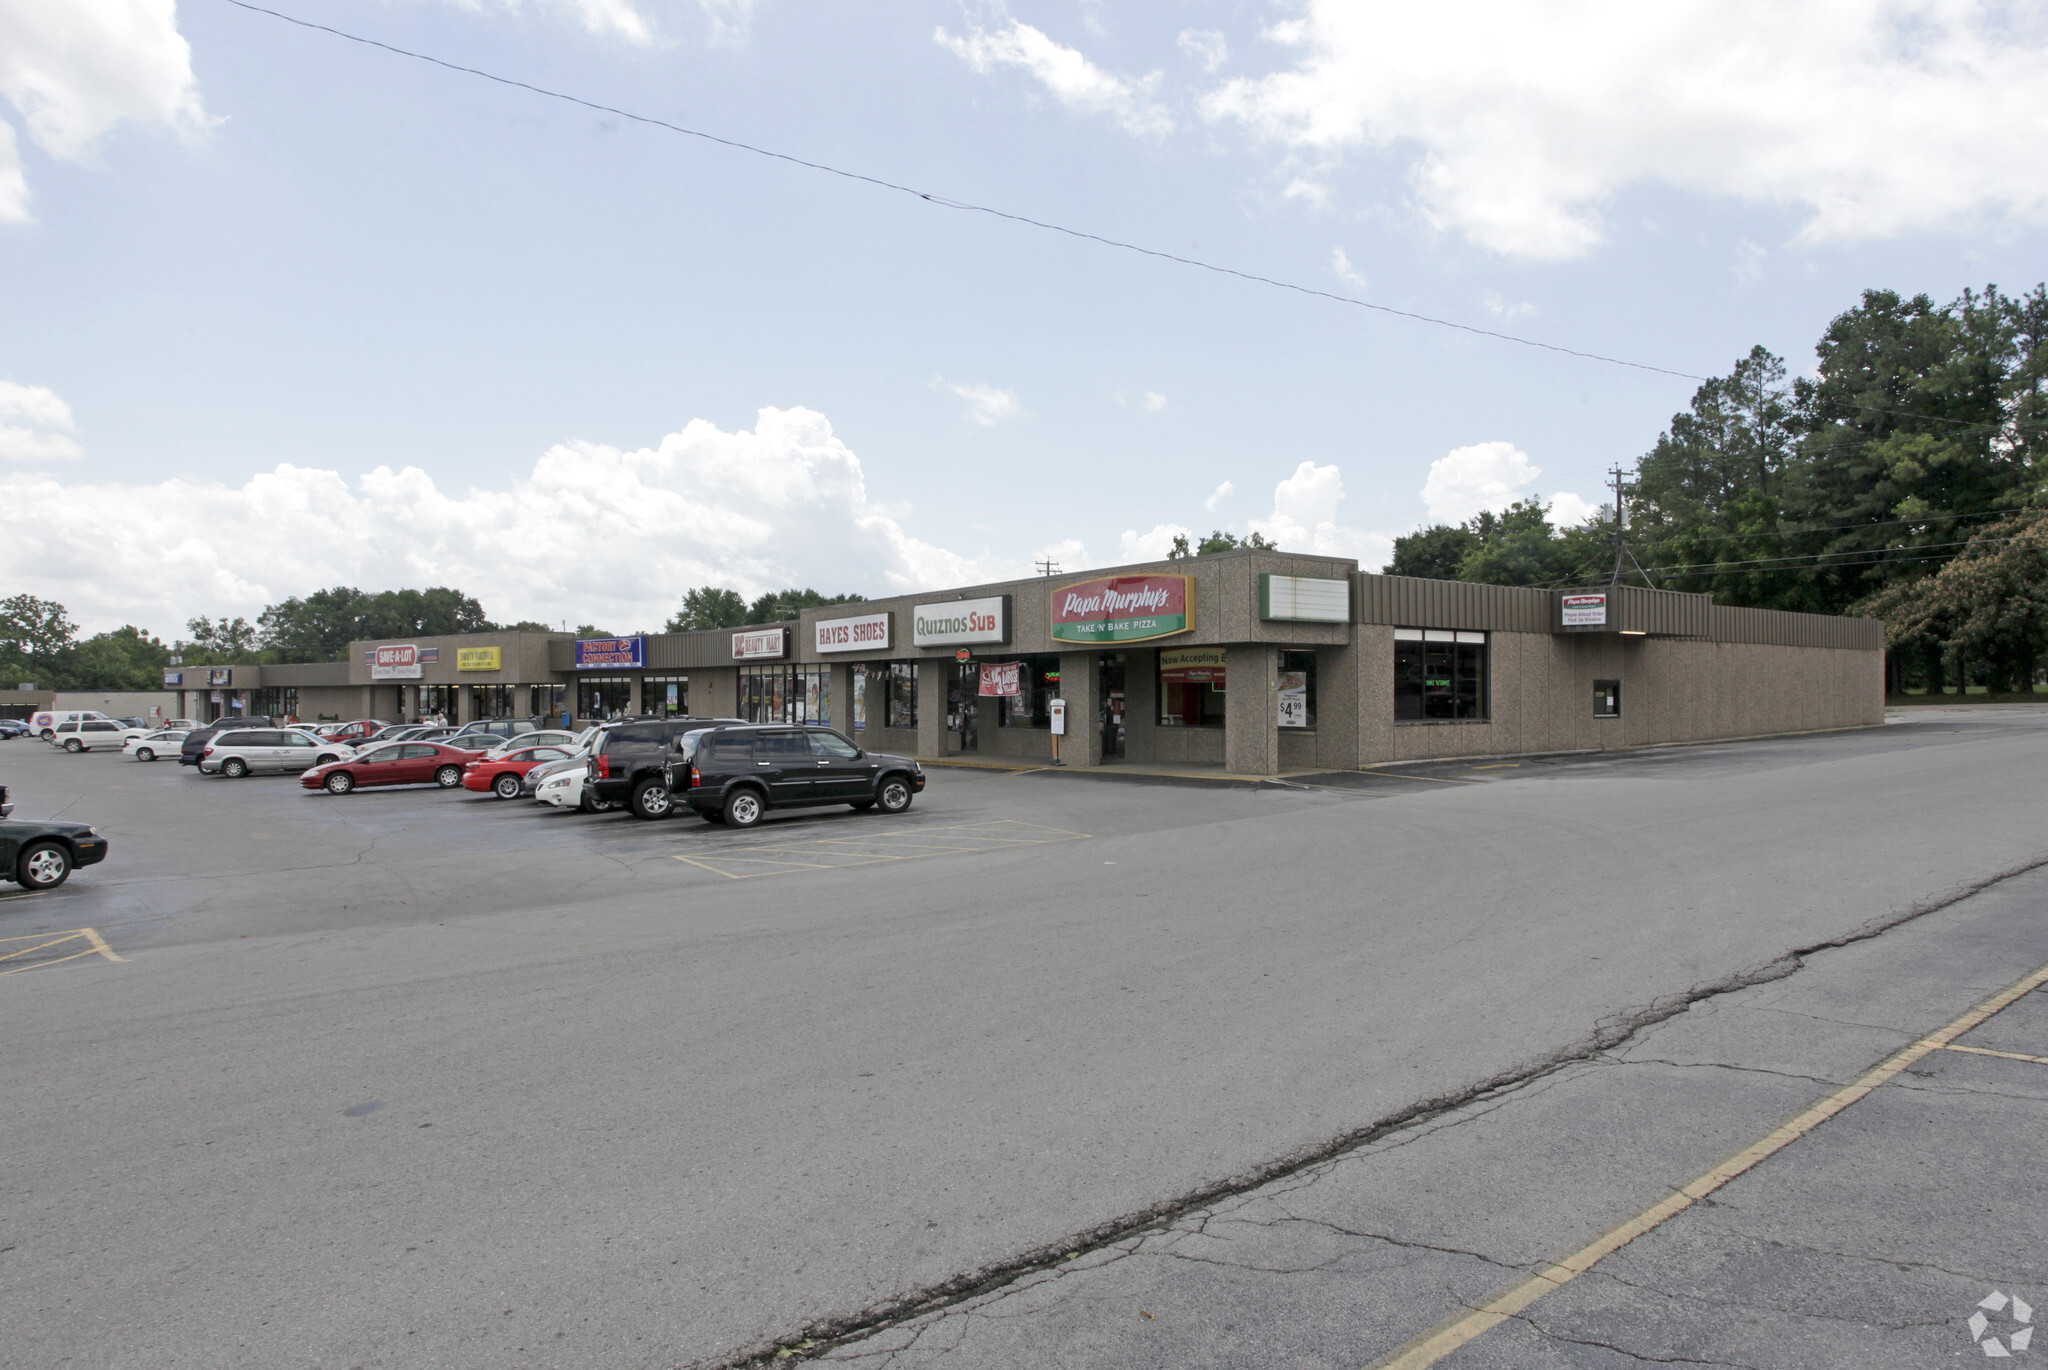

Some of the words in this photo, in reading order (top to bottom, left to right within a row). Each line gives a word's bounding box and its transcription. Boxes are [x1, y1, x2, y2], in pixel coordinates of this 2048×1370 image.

[1062, 593, 1101, 617] Papa
[1101, 585, 1169, 613] Murphy's
[820, 625, 849, 645] HAYES
[853, 621, 885, 642] SHOES
[1077, 624, 1096, 633] TAKE
[1108, 622, 1129, 631] BAKE
[1133, 620, 1157, 629] PIZZA
[583, 641, 616, 652] FACTORY
[745, 638, 764, 652] BEAUTY
[379, 650, 412, 663] SAVE-A-LOT
[582, 652, 633, 663] CONNECTION
[1161, 656, 1179, 665] Now
[1180, 653, 1219, 664] Accepting
